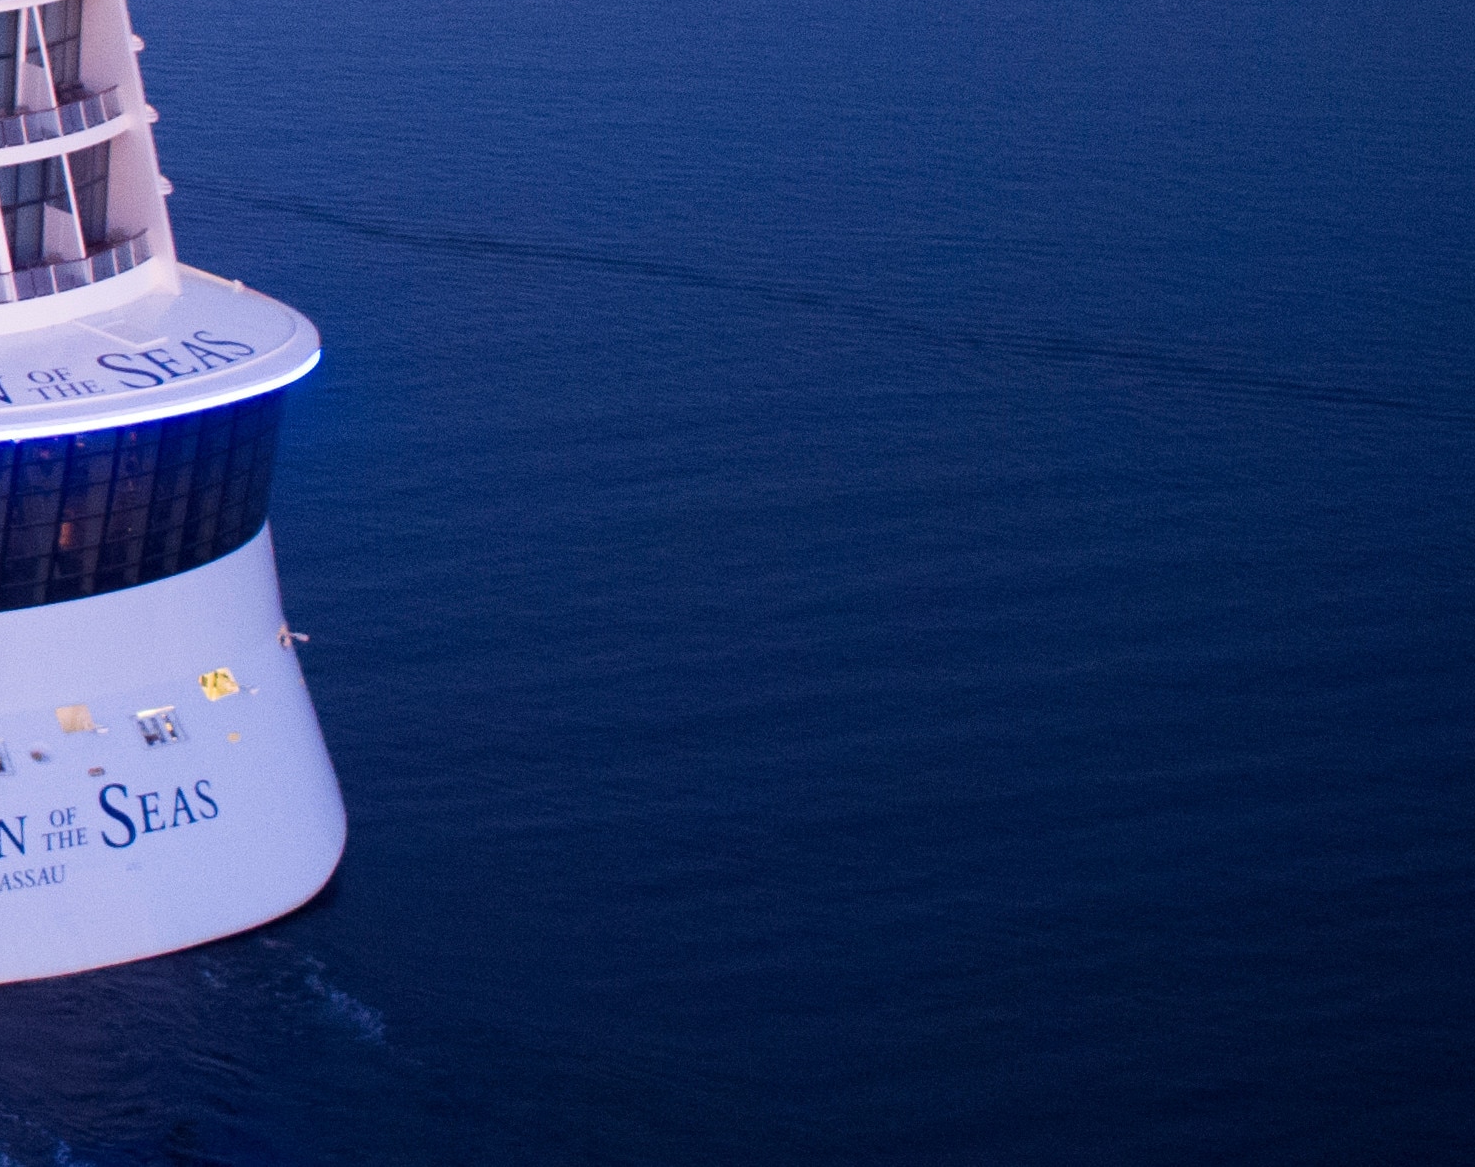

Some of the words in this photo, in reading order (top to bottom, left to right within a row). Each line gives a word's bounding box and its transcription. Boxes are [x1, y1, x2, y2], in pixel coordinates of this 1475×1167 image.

[96, 329, 256, 390] SEAS
[26, 366, 75, 387] OF
[27, 377, 106, 402] THE
[48, 806, 77, 829] OF
[98, 779, 219, 849] SEAS
[41, 827, 88, 852] THE
